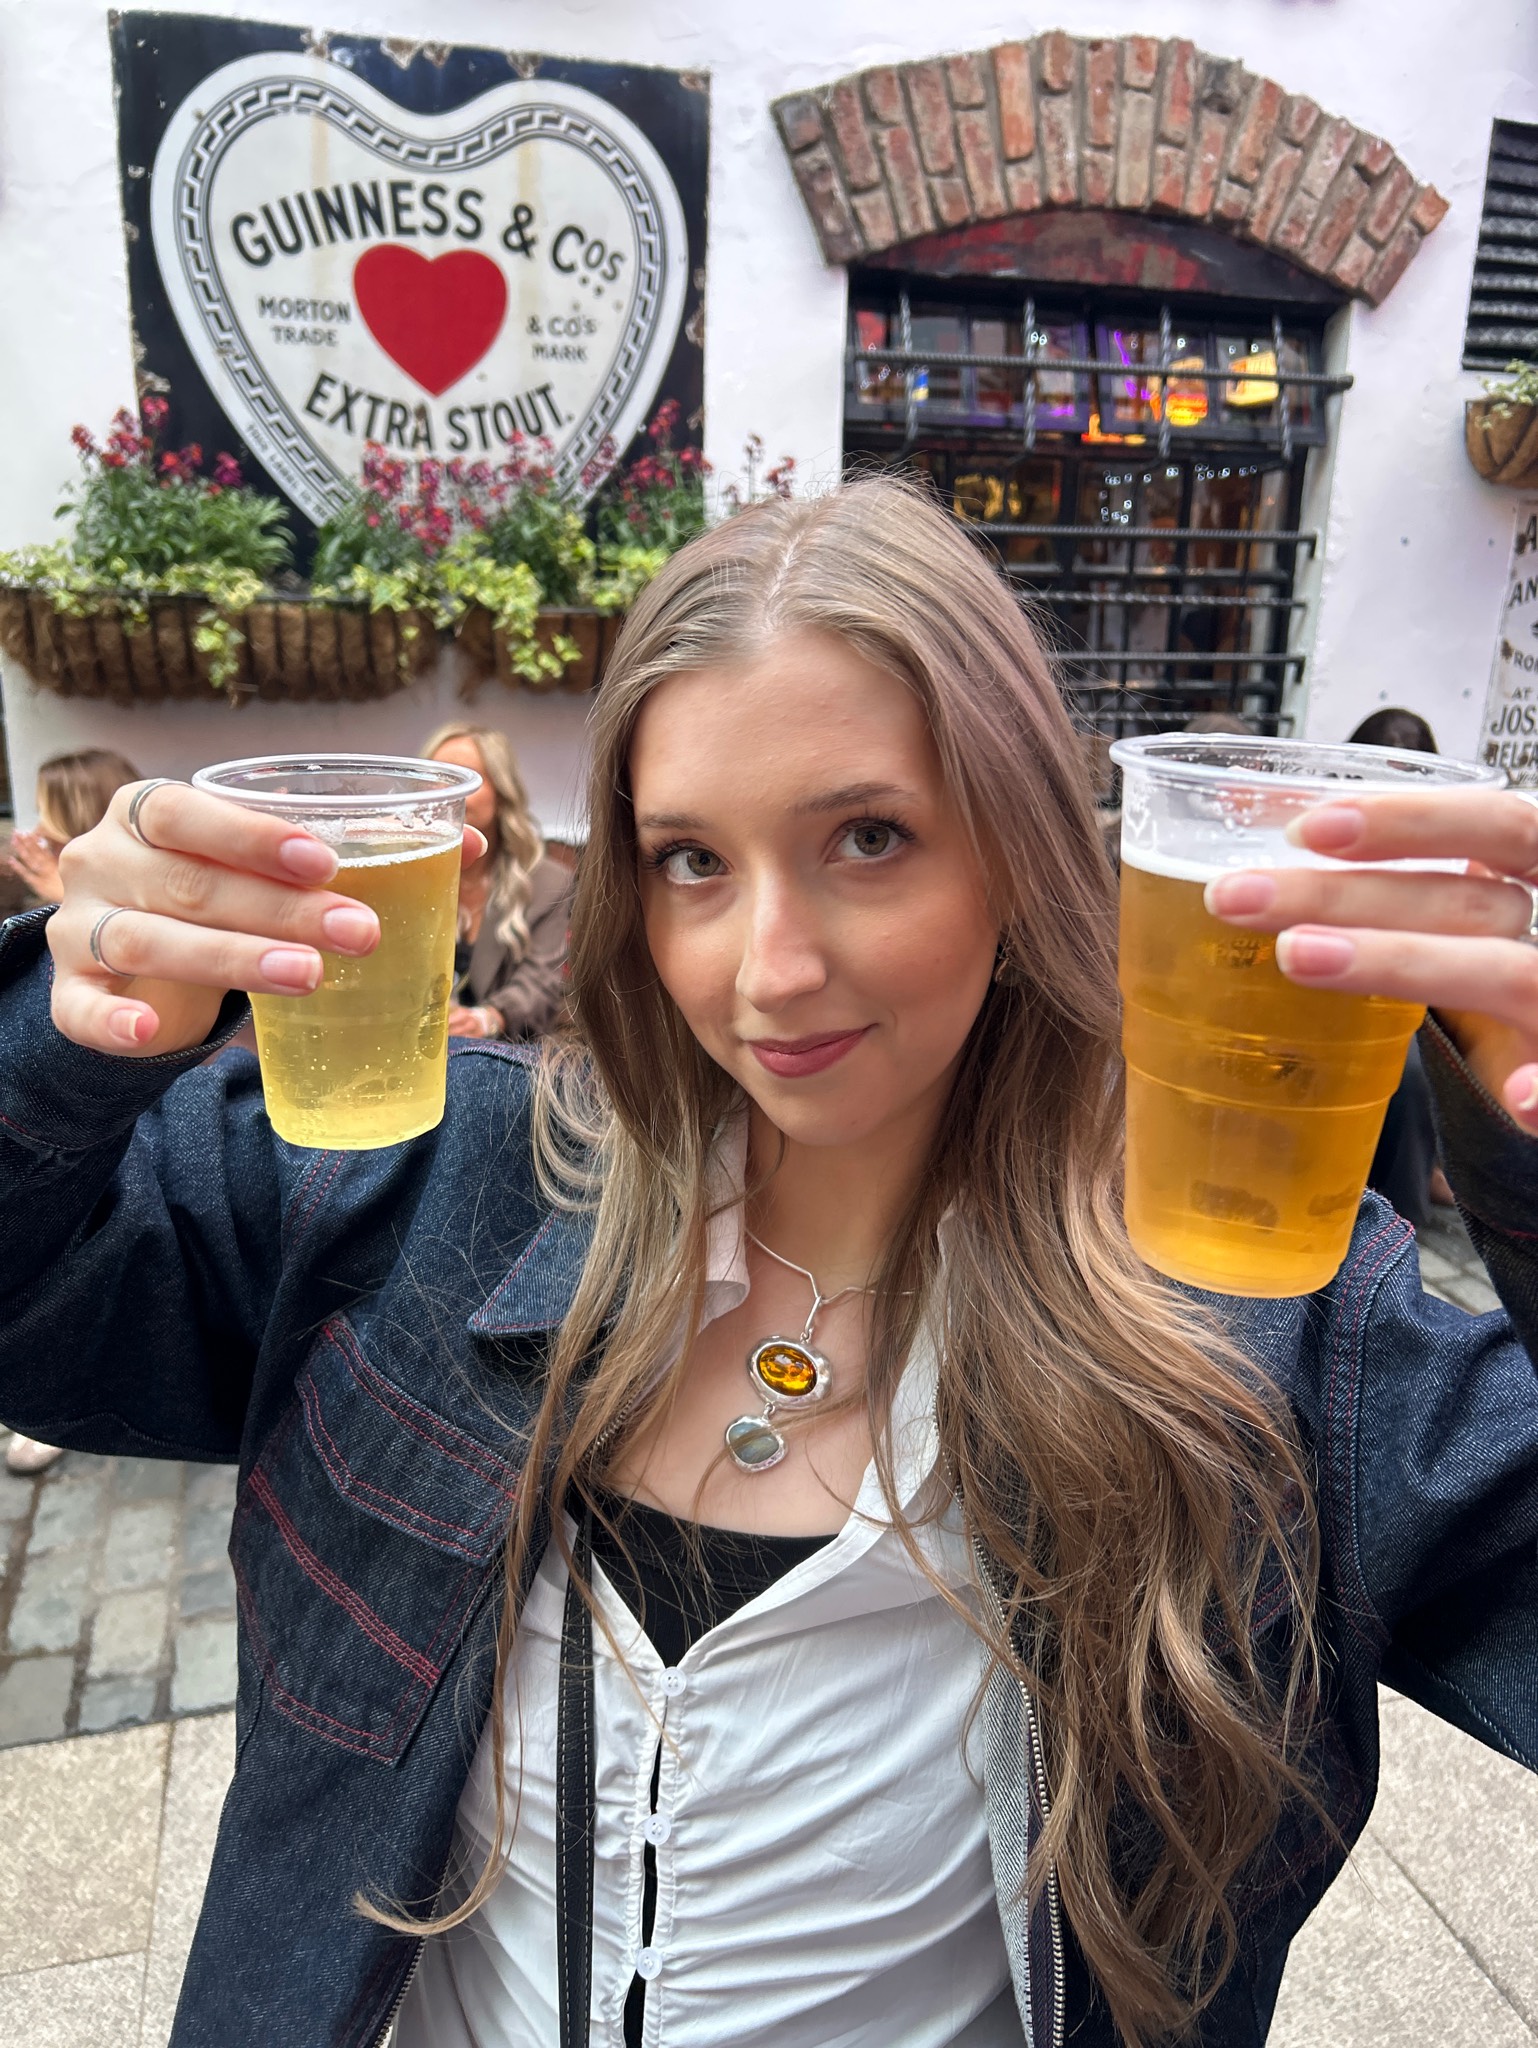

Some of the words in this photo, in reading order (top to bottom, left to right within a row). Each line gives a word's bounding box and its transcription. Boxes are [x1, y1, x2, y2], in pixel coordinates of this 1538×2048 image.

[231, 180, 484, 268] GUINNESS
[502, 203, 538, 260] &
[257, 295, 351, 323] MORTON
[525, 314, 544, 335] &
[271, 325, 339, 347] TRADE
[532, 343, 588, 363] MARK
[303, 371, 433, 450] EXTRA
